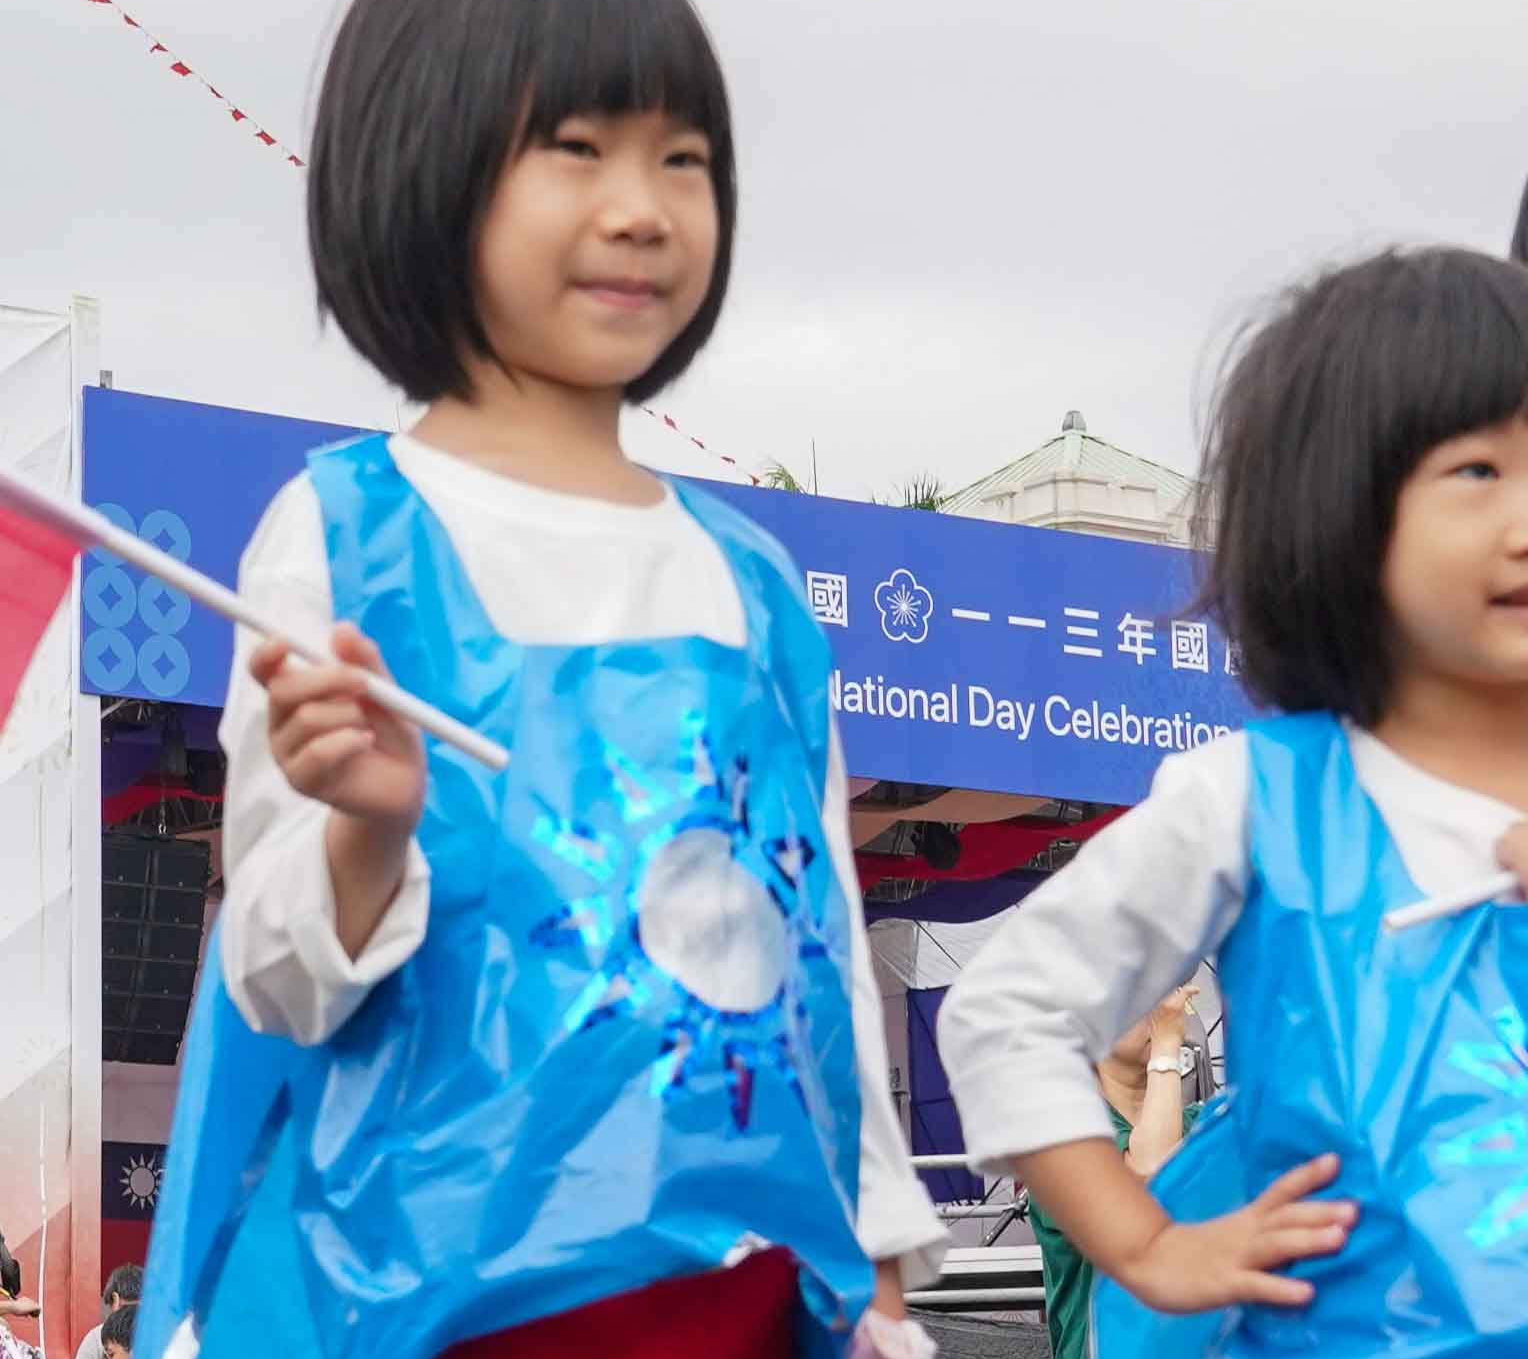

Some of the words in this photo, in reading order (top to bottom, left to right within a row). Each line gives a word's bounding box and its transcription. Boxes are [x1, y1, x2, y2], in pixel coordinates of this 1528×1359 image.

[952, 607, 1243, 676] 一一三年國
[969, 686, 1036, 740] Day
